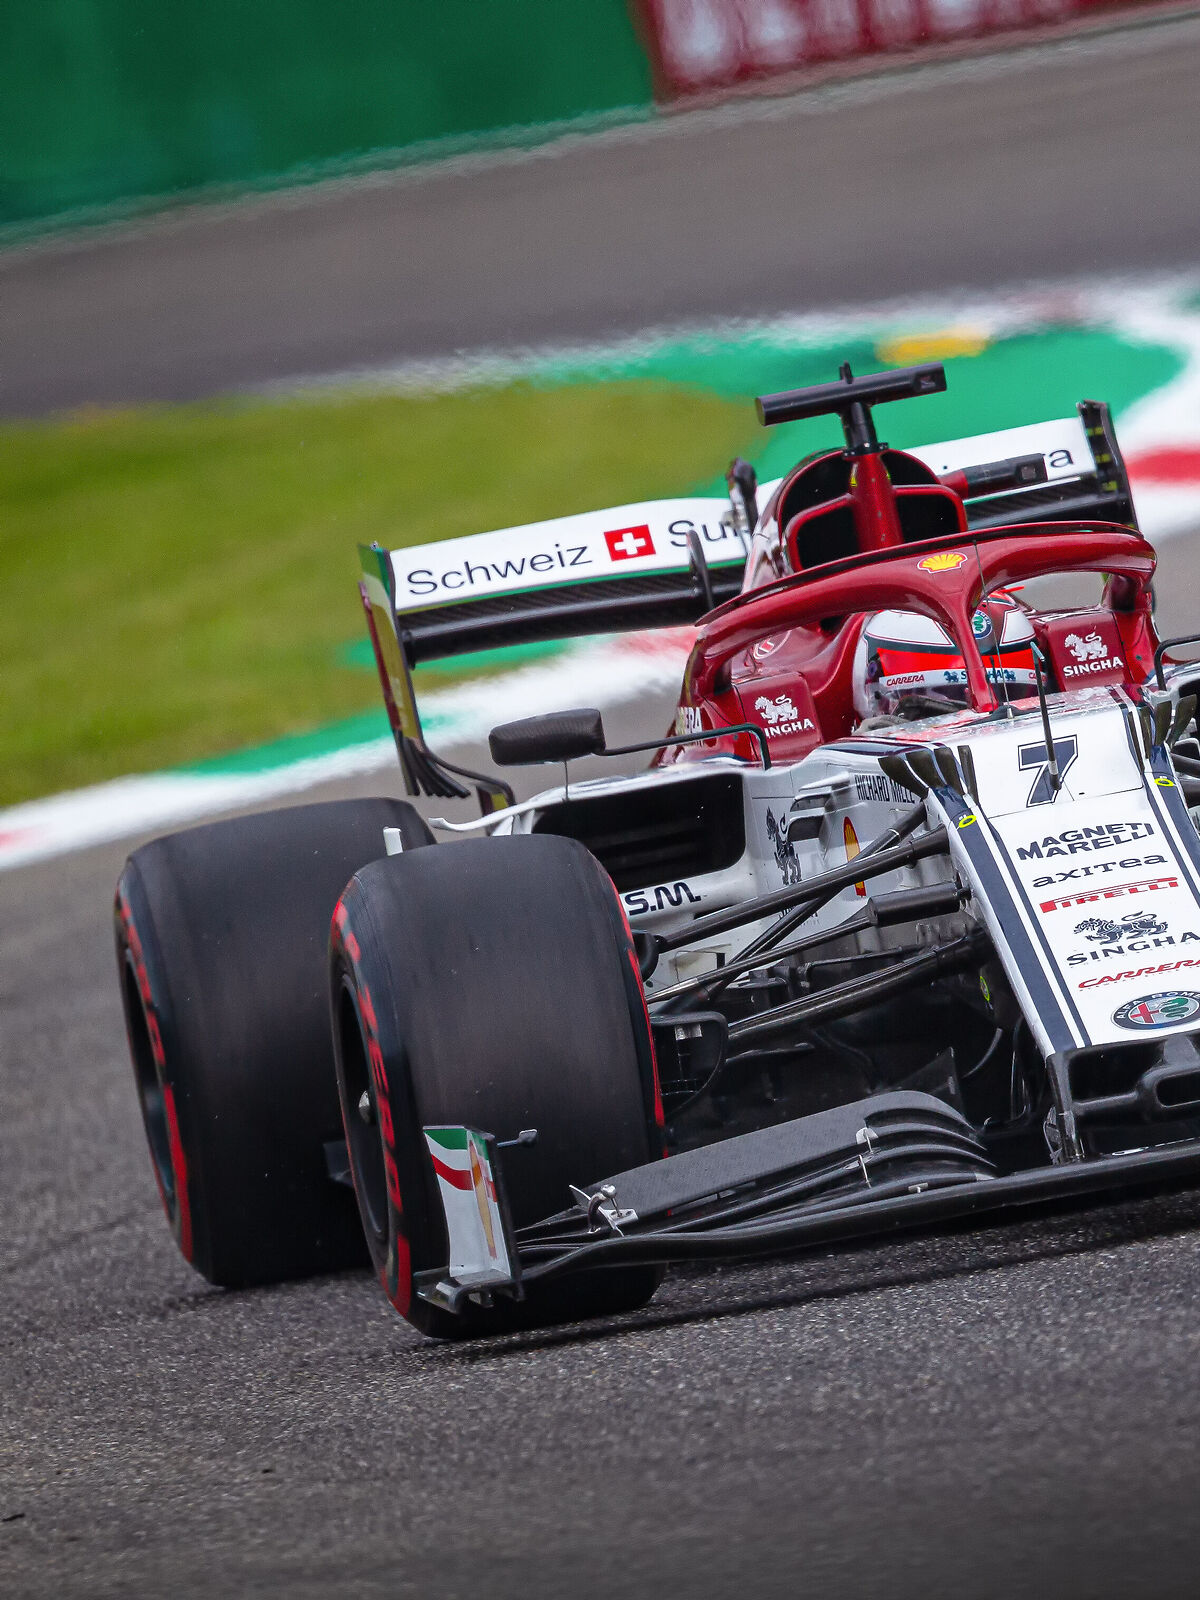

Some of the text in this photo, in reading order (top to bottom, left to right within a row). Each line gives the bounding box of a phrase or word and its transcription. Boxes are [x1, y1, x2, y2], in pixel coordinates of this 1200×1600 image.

[406, 543, 593, 597] Schweiz
[886, 674, 926, 687] CARRERA
[1063, 656, 1124, 677] SINGHA
[763, 718, 815, 738] INGHA
[1017, 734, 1079, 808] 7
[854, 774, 892, 802] RICHARD
[1016, 823, 1155, 856] MAGNETI
[1016, 831, 1155, 861] MARELLI
[624, 881, 702, 916] S.M.
[1039, 877, 1179, 914] PIRELLI
[1116, 999, 1145, 1019] ALFA
